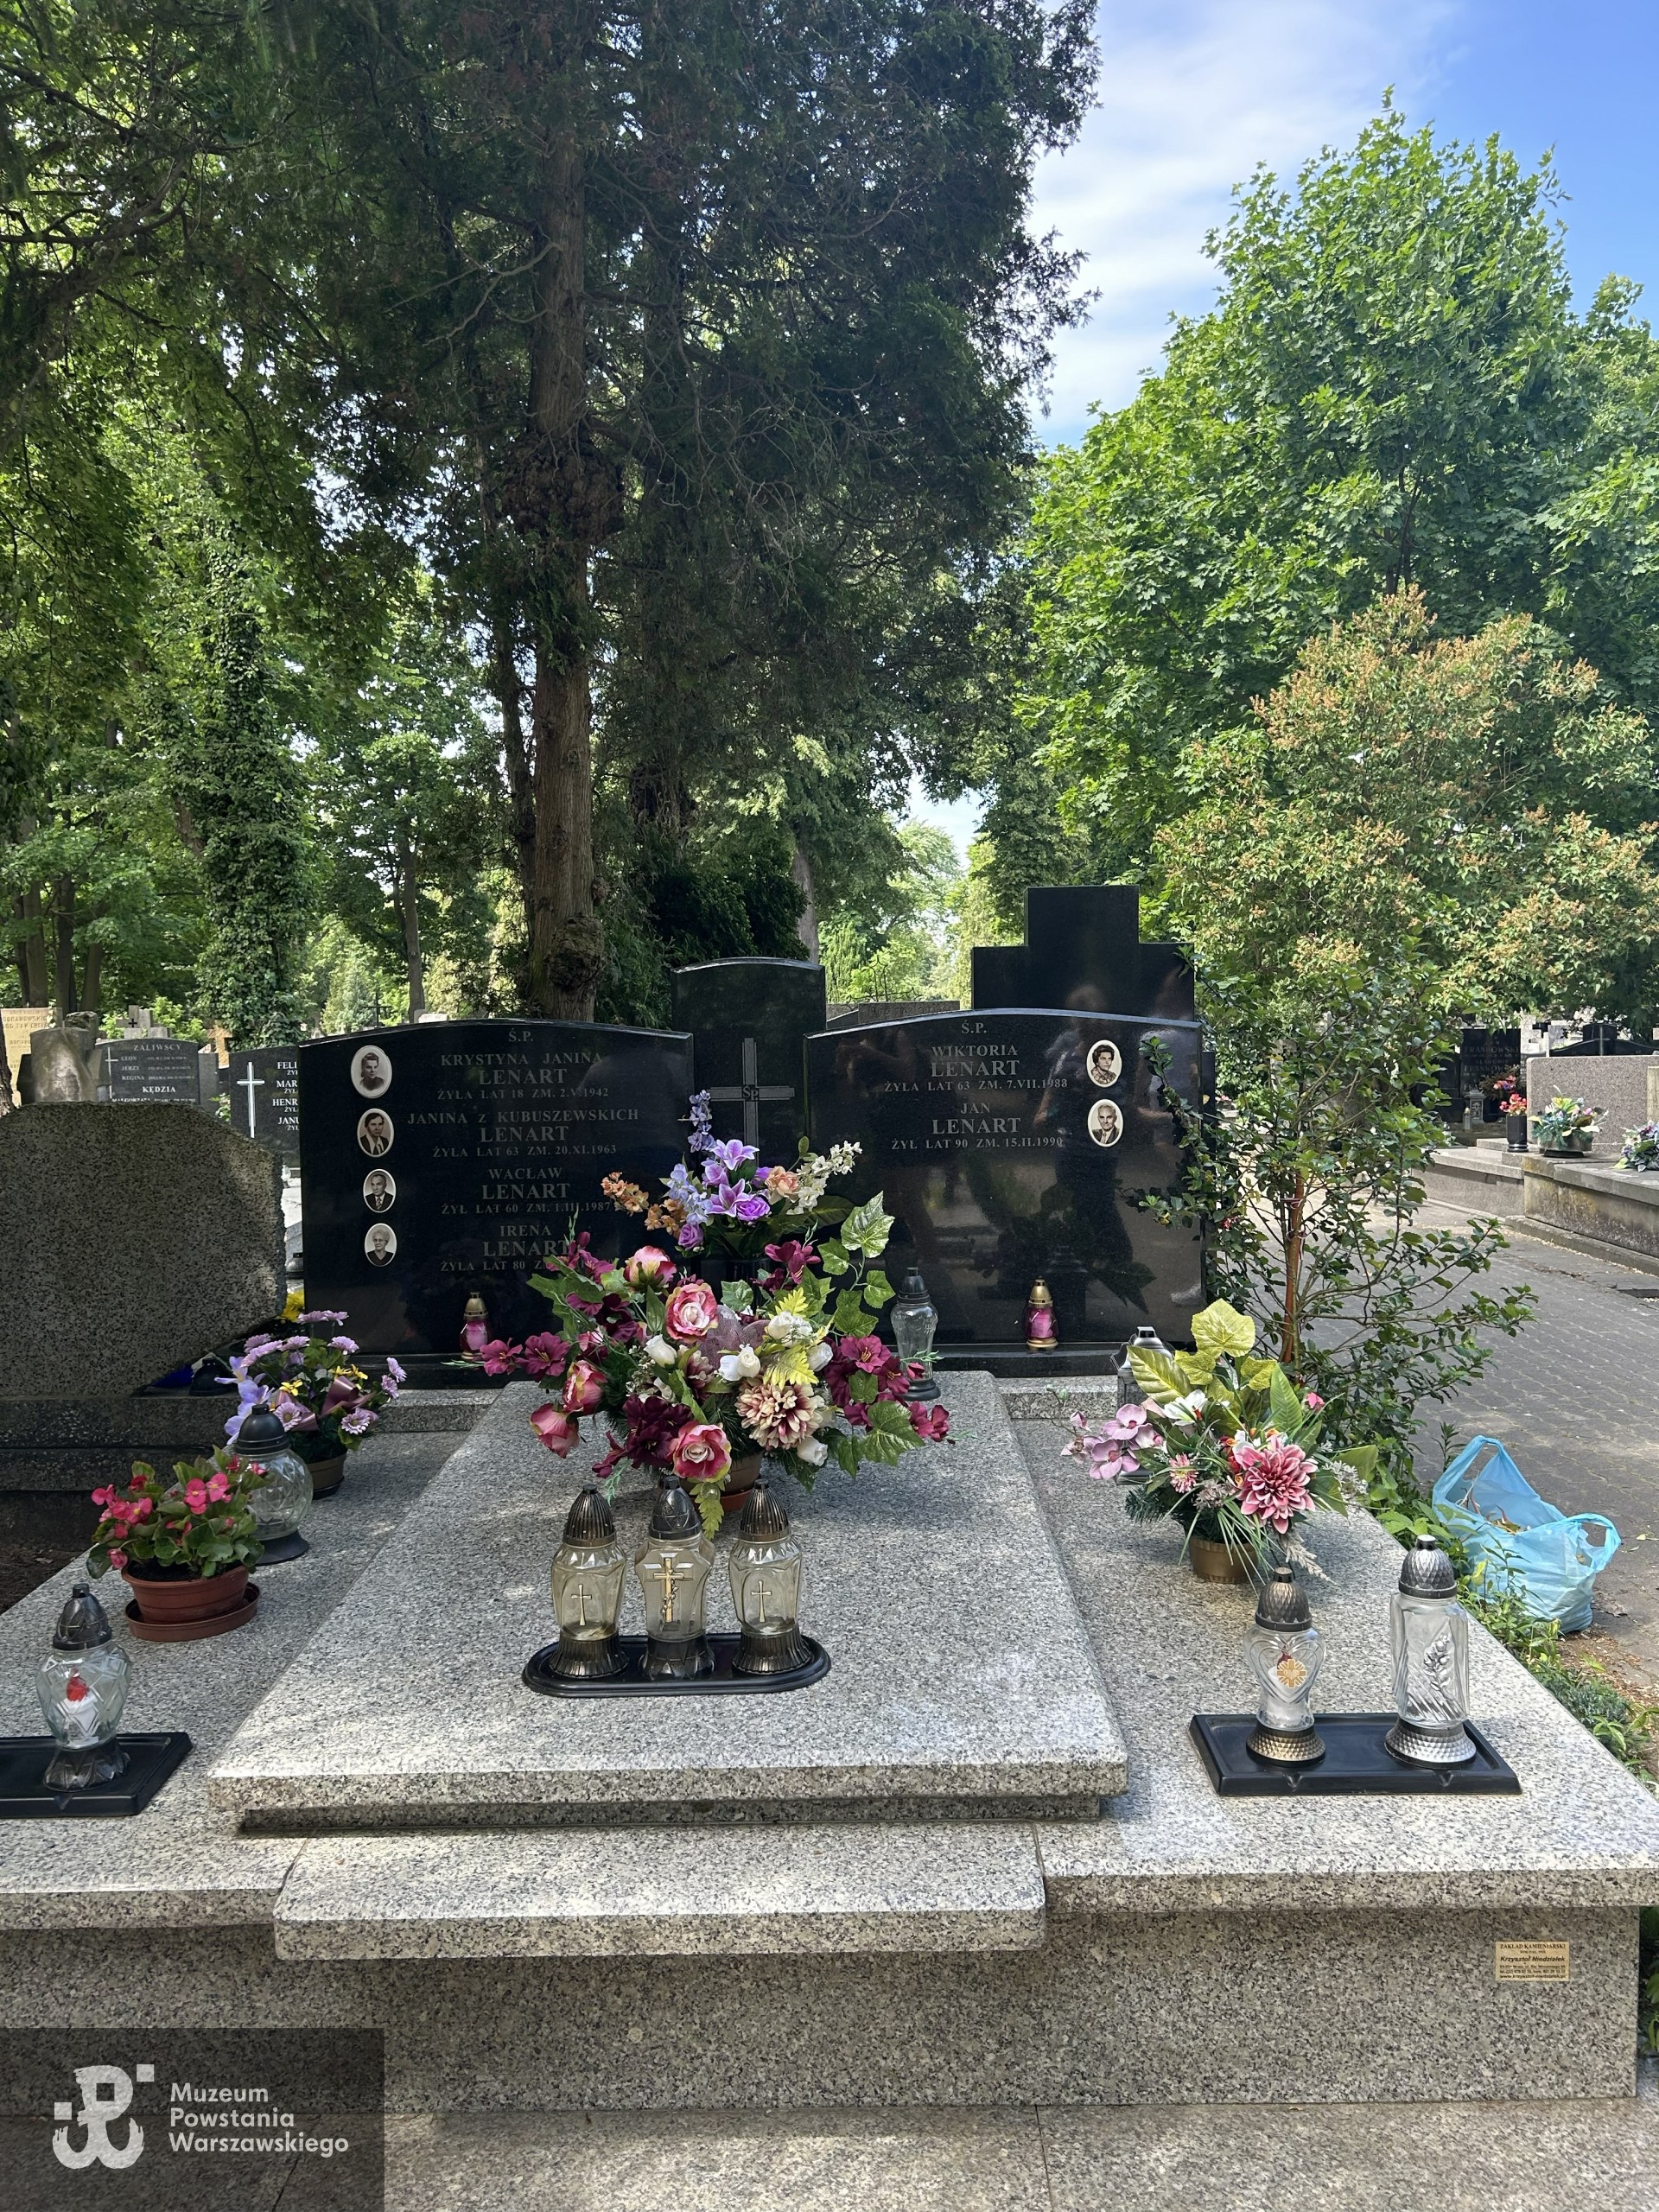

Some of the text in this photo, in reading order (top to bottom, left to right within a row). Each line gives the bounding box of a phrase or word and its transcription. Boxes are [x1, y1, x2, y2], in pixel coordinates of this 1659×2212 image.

[961, 1020, 988, 1033] Ś.P.
[508, 1028, 534, 1042] Ś.P.
[931, 1044, 1018, 1057] WIKTORIA
[441, 1052, 603, 1066] KRYSTYNA JANINA
[931, 1059, 1020, 1077] LENART
[479, 1068, 568, 1085] LENART
[884, 1078, 1068, 1092] ŻYŁA LAT 63 ZM. 7.VII.1988
[437, 1087, 609, 1100] ŻYŁA LAT 18 ZM. 2.V.1942
[960, 1103, 991, 1115] JAN
[408, 1112, 468, 1125] JANINA
[498, 1109, 639, 1123] KUBUSZEWSKICH
[932, 1117, 1021, 1135] LENART
[480, 1126, 569, 1142] LENART
[892, 1137, 1063, 1150] ŻYŁ LAT 90 ZM. 15.II.1990
[433, 1145, 617, 1158] ŻYŁA LAT 63 ZM. 20.XI.1963
[488, 1167, 563, 1180] WACŁAW
[482, 1183, 570, 1200] LENART
[442, 1203, 468, 1215] ŻYŁ
[476, 1205, 501, 1214] LAT
[505, 1204, 518, 1213] 60
[526, 1203, 550, 1213] ZM.
[499, 1224, 552, 1237] IRENA
[483, 1240, 570, 1257] LENART
[441, 1260, 474, 1272] ŻYŁA
[483, 1261, 507, 1271] LAT
[512, 1261, 525, 1270] 80
